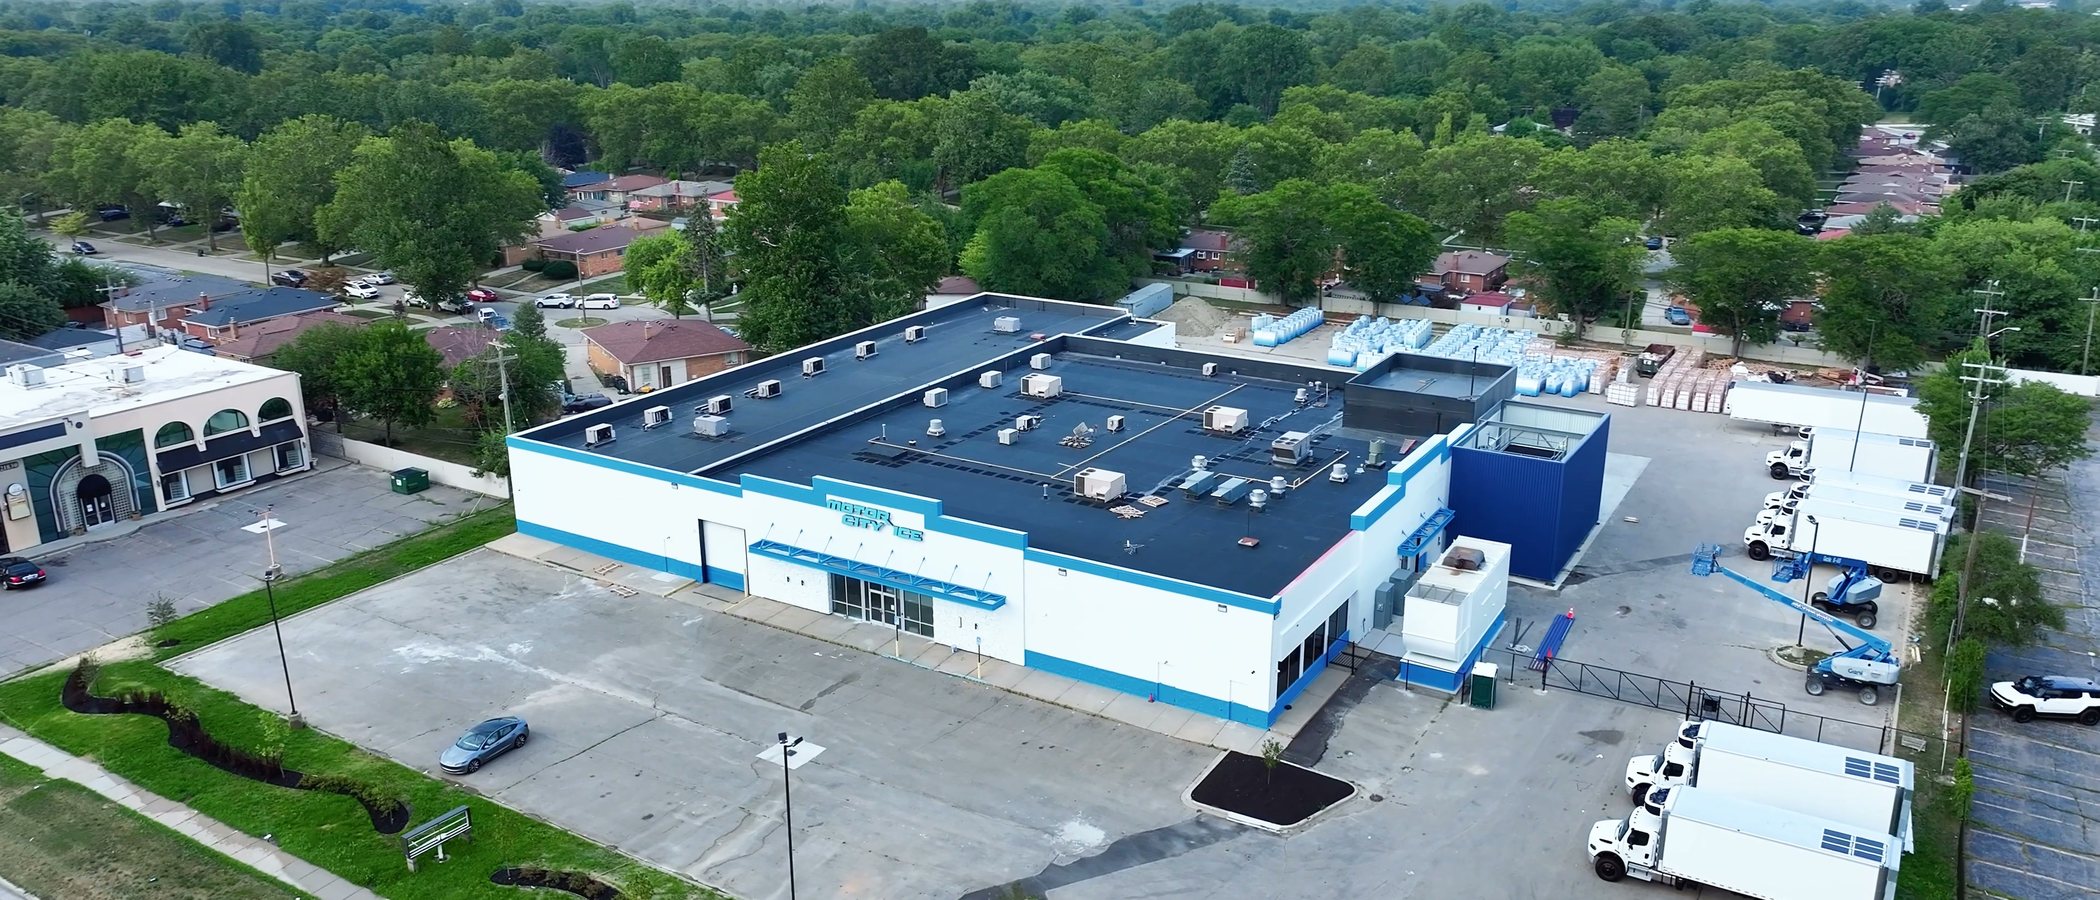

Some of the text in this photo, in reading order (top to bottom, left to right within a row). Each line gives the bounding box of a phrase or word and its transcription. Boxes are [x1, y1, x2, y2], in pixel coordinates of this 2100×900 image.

[826, 499, 893, 524] MOTOR
[841, 513, 924, 541] CITY ICE
